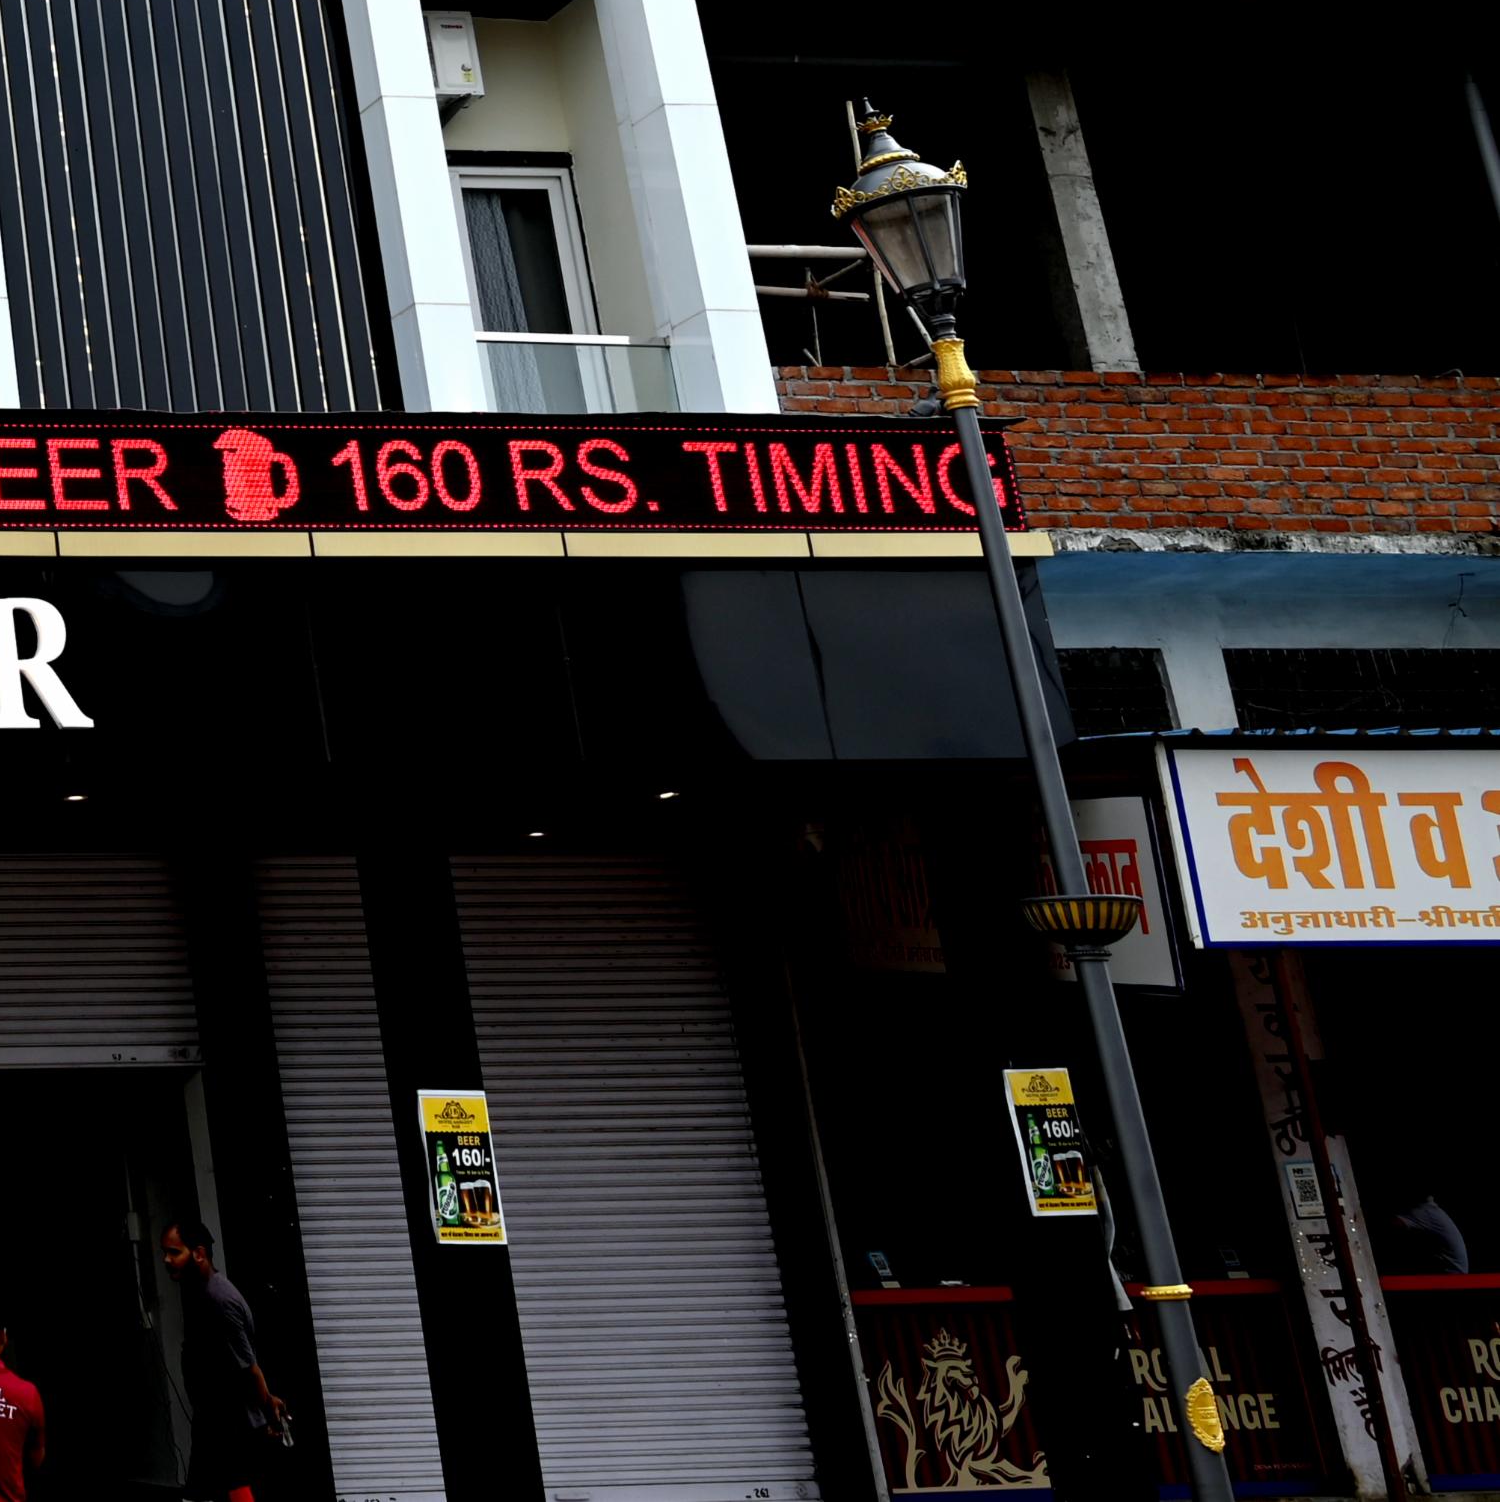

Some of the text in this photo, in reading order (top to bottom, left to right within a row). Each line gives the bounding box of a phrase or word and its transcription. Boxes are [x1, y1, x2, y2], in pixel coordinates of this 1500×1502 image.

[331, 439, 482, 511] 160
[508, 439, 660, 514] RS.
[1215, 758, 1396, 890] देशी
[1397, 792, 1472, 889] व
[1046, 1108, 1069, 1118] BEER
[1042, 1120, 1080, 1138] 160/-
[457, 1135, 481, 1147] BEER
[452, 1148, 491, 1167] 160/-
